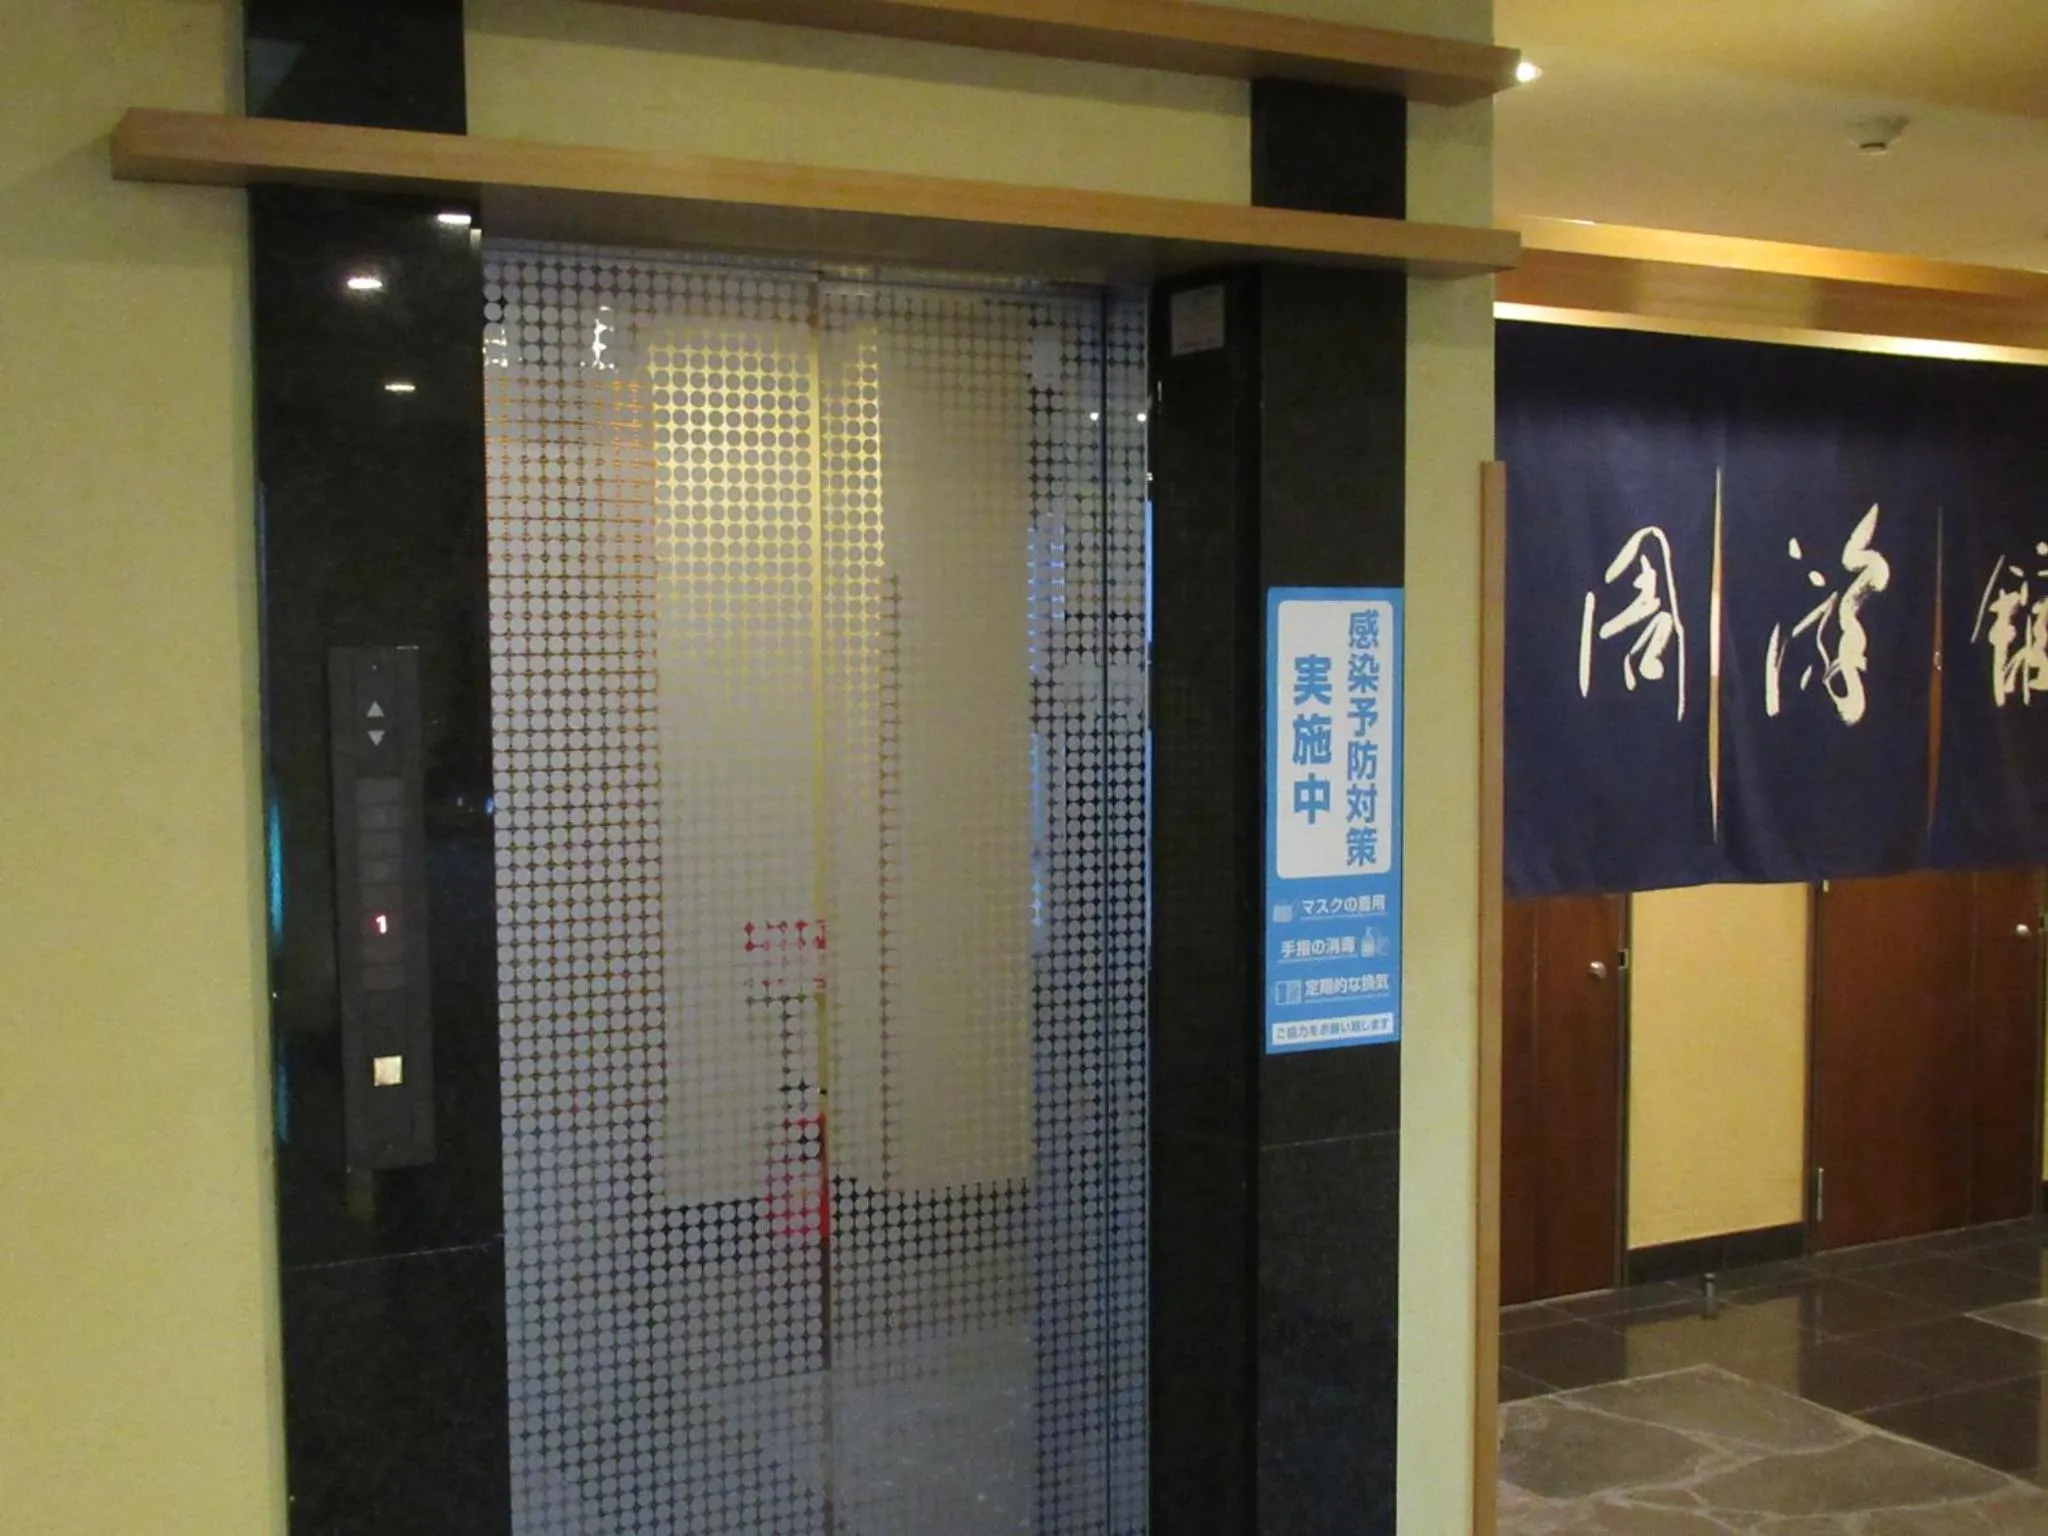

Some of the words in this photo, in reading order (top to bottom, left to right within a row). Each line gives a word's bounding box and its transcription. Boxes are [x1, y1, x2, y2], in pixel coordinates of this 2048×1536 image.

[1293, 654, 1333, 825] 実施中
[1346, 609, 1380, 867] 感染予防対策
[1302, 894, 1386, 915] マスクの着用
[376, 915, 387, 934] 1
[1281, 936, 1355, 958] 手指の消毒
